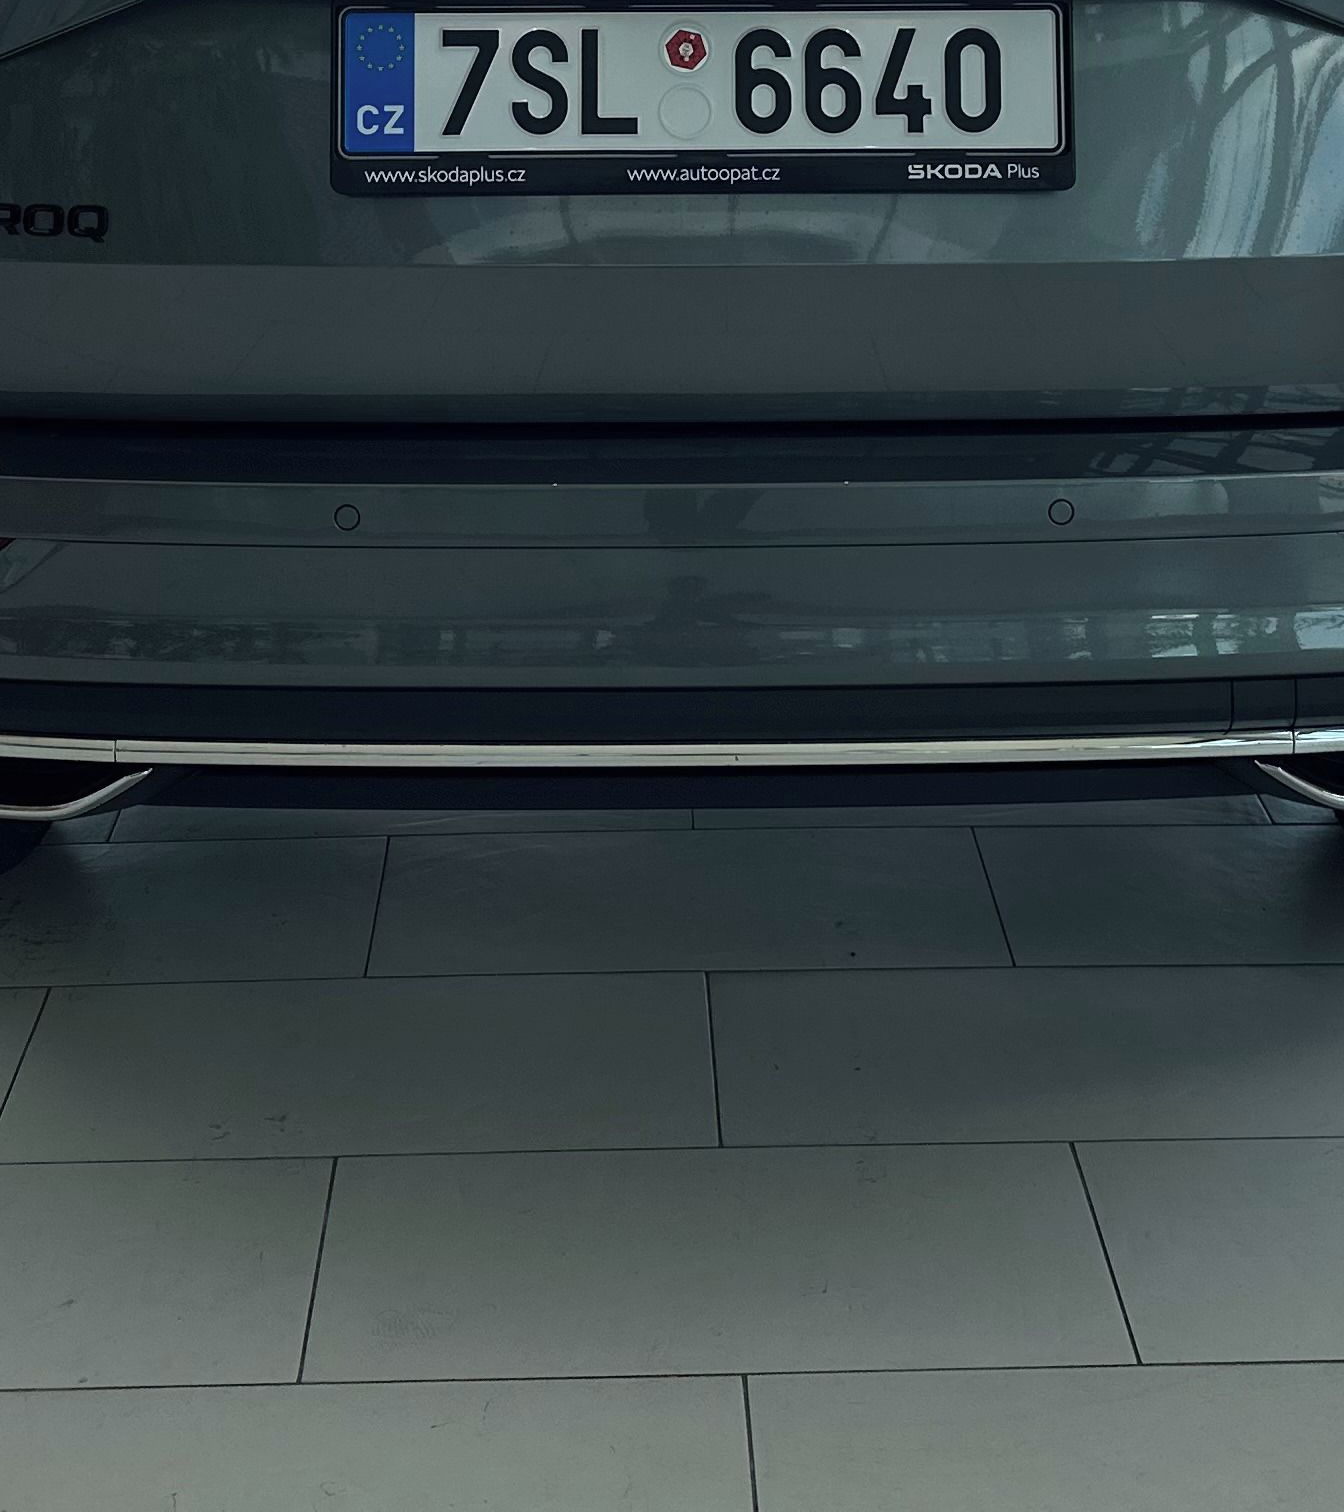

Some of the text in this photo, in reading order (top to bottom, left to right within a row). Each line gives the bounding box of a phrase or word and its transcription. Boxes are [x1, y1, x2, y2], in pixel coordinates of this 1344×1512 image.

[441, 27, 1002, 136] 7SL 6640
[356, 104, 405, 135] CZ
[364, 165, 526, 187] www.skodaplus.cz
[626, 165, 781, 185] www.autoopat.cz
[907, 163, 1040, 180] SKODA Plus
